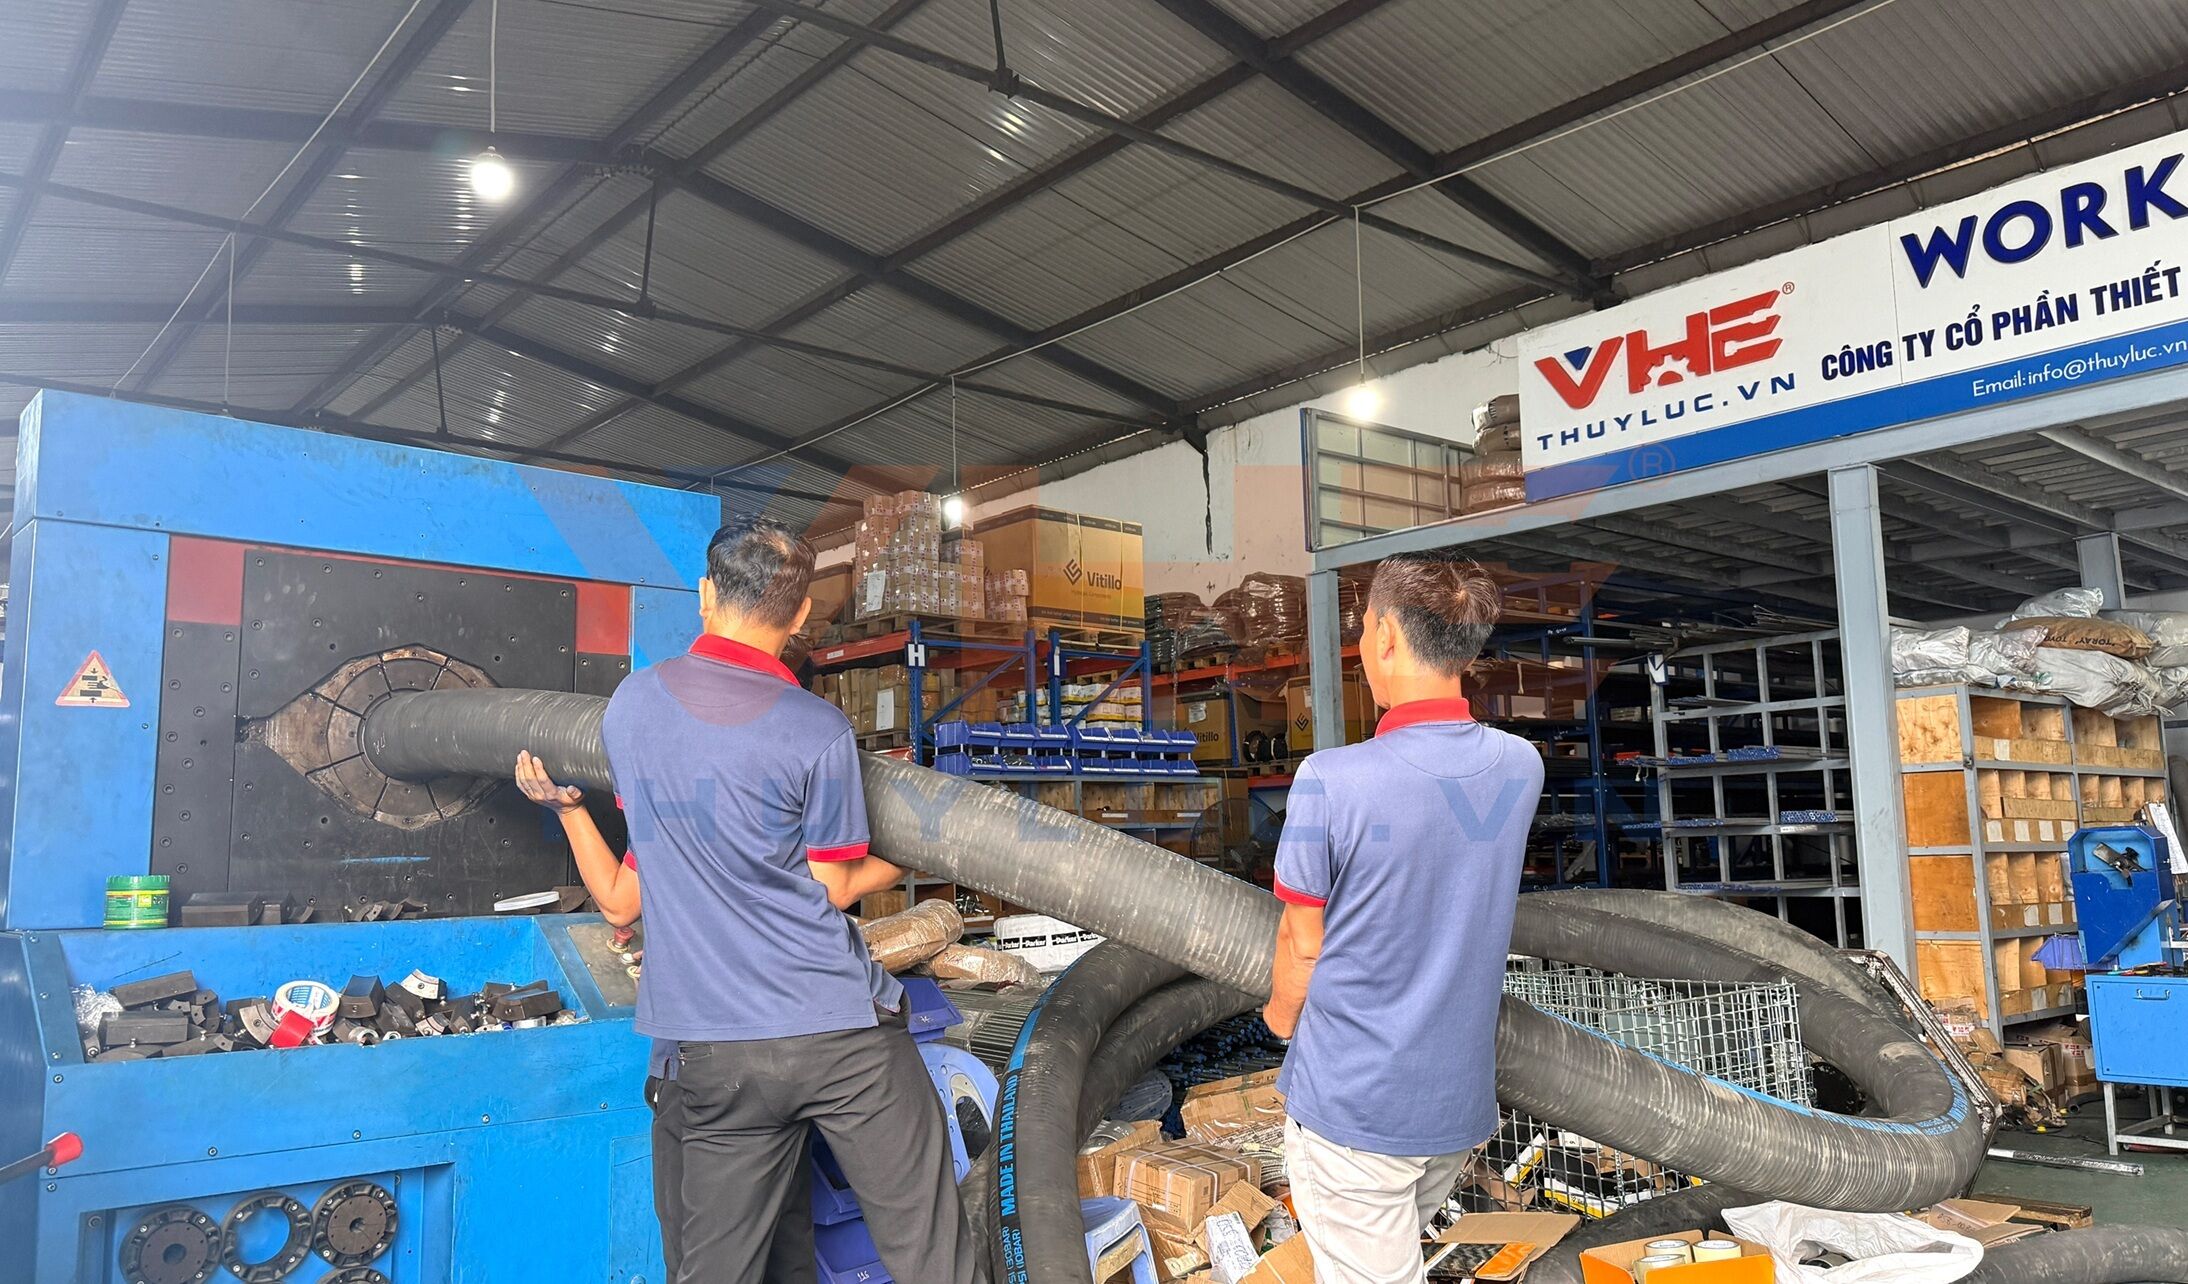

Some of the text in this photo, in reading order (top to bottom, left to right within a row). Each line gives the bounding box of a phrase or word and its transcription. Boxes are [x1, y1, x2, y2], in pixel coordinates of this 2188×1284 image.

[1899, 152, 2188, 289] WORK
[1534, 289, 1783, 410] VHE
[1821, 259, 2182, 381] CÔNG TY CỔ PHẦN THIẾT
[1536, 372, 1796, 451] THUYLUC.VN
[1087, 570, 1123, 591] Vitillo
[908, 643, 926, 667] H
[1025, 940, 1046, 948] Parker
[1000, 1075, 1019, 1217] MADE IN THAILAND
